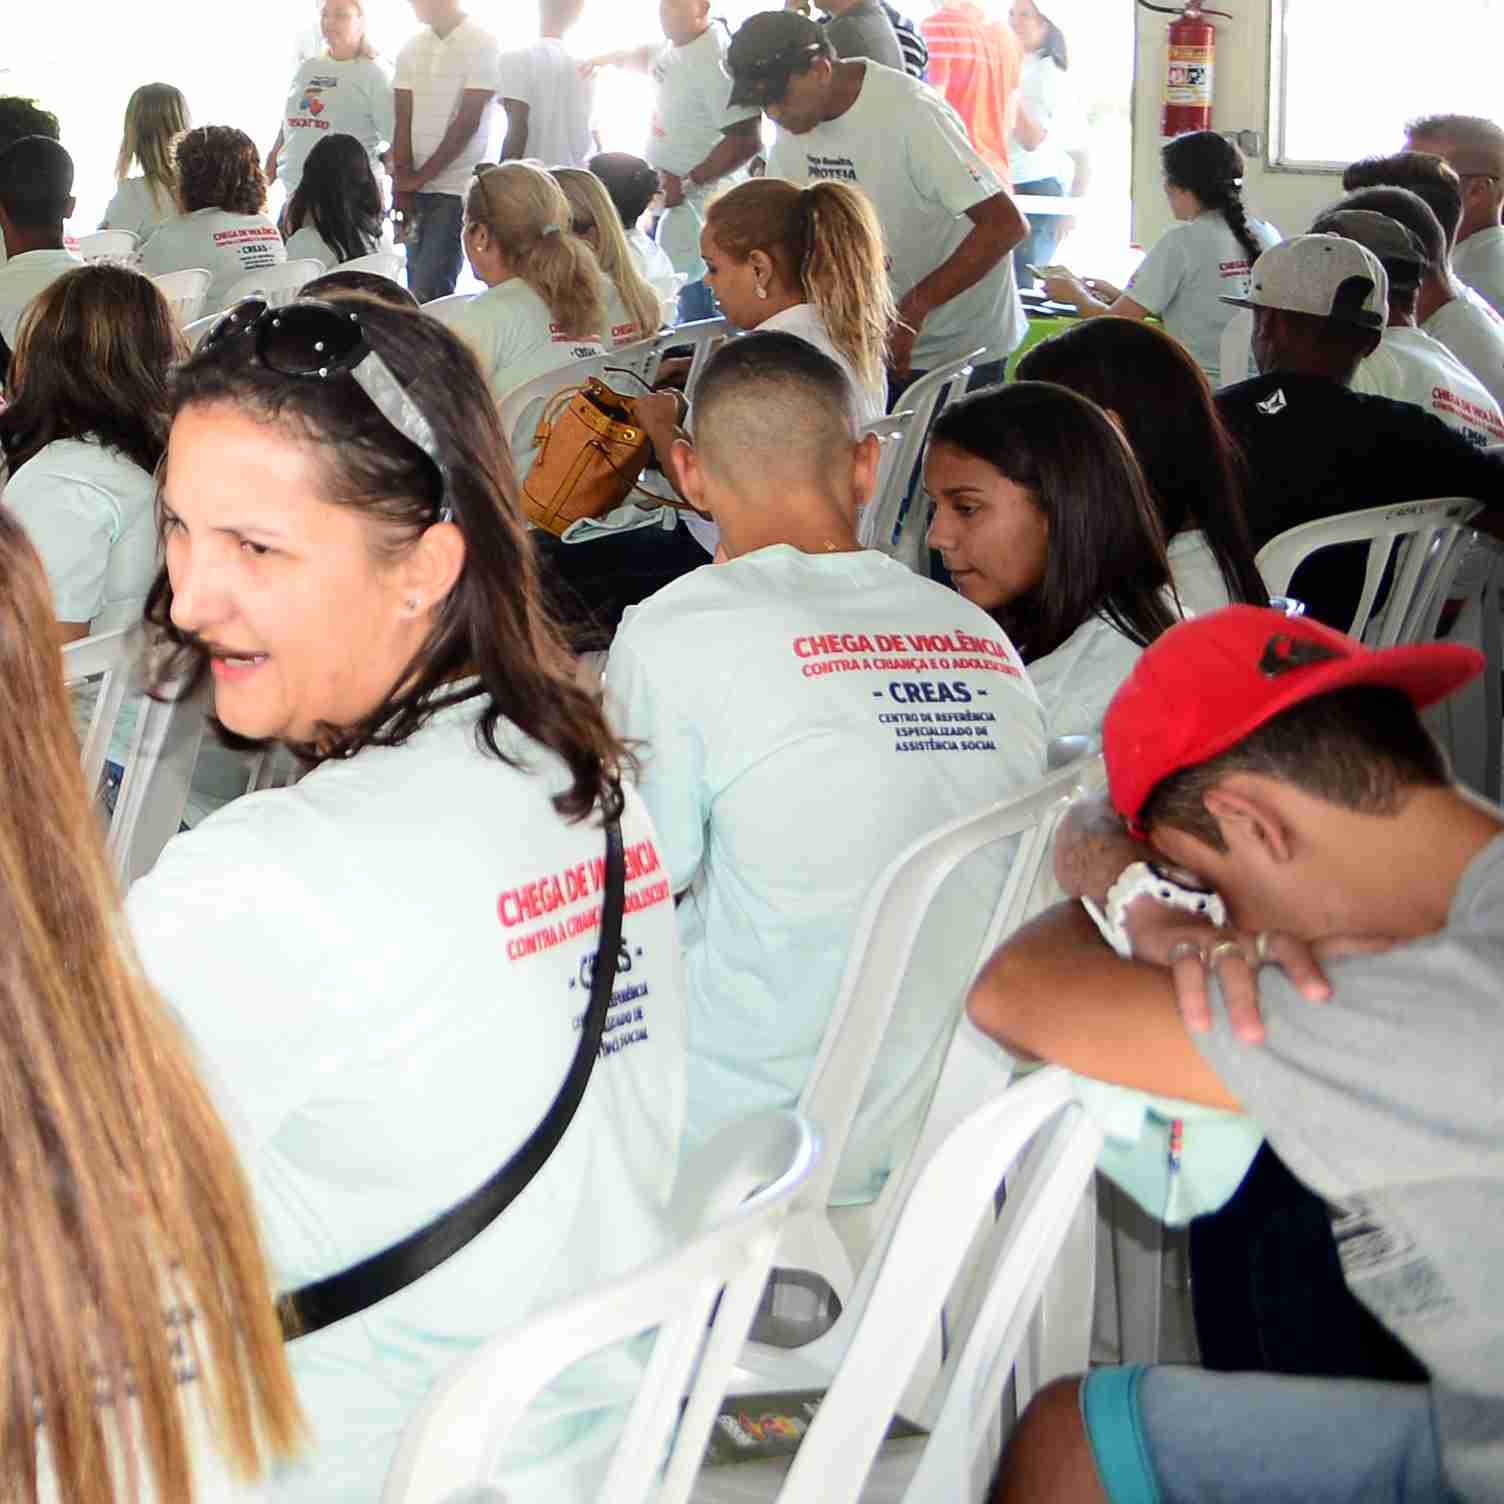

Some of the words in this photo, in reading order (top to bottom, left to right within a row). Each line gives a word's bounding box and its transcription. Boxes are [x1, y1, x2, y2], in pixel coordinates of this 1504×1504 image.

[793, 632, 875, 658] CHEGA
[875, 633, 904, 653] DE
[906, 629, 1010, 661] VIOLÊNCIA
[801, 658, 862, 678] CONTRA
[863, 658, 873, 671] A
[872, 658, 930, 674] CRIANÇA
[931, 659, 940, 670] E
[942, 658, 952, 670] O
[888, 680, 973, 704] CREAS
[878, 711, 919, 724] CENTRO
[920, 712, 934, 724] DE
[934, 708, 997, 723] REFERÊNCIA
[894, 738, 960, 752] ASSISTÊNCIA
[960, 740, 997, 752] SOCIAL
[497, 872, 567, 929] CHEGA
[563, 861, 590, 904] DE
[588, 839, 661, 902] VINCIA
[505, 923, 558, 961] CONTRA
[566, 904, 602, 938] CRIANÇ
